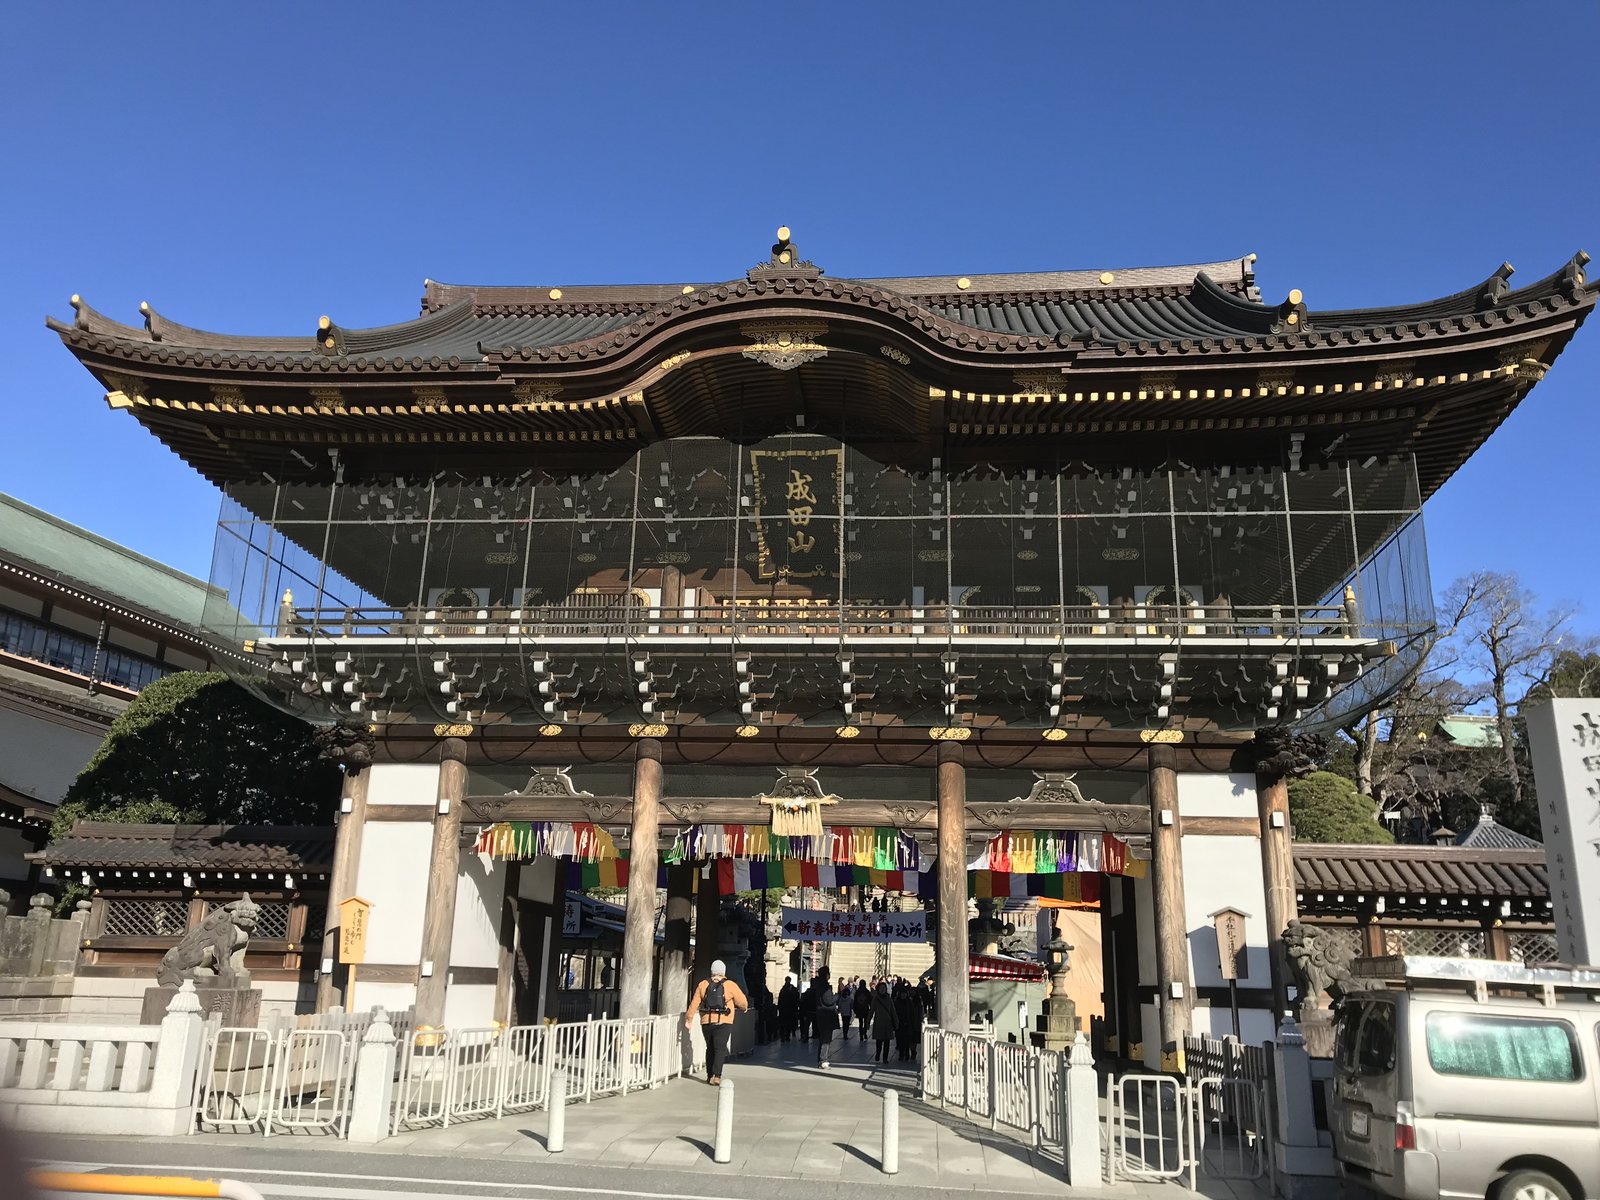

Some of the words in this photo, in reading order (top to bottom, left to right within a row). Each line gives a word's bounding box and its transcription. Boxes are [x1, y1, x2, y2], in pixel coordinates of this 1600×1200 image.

[785, 469, 817, 554] 成田山
[831, 912, 888, 923] 謹賀新年
[797, 920, 923, 939] 新春御護摩札申込所
